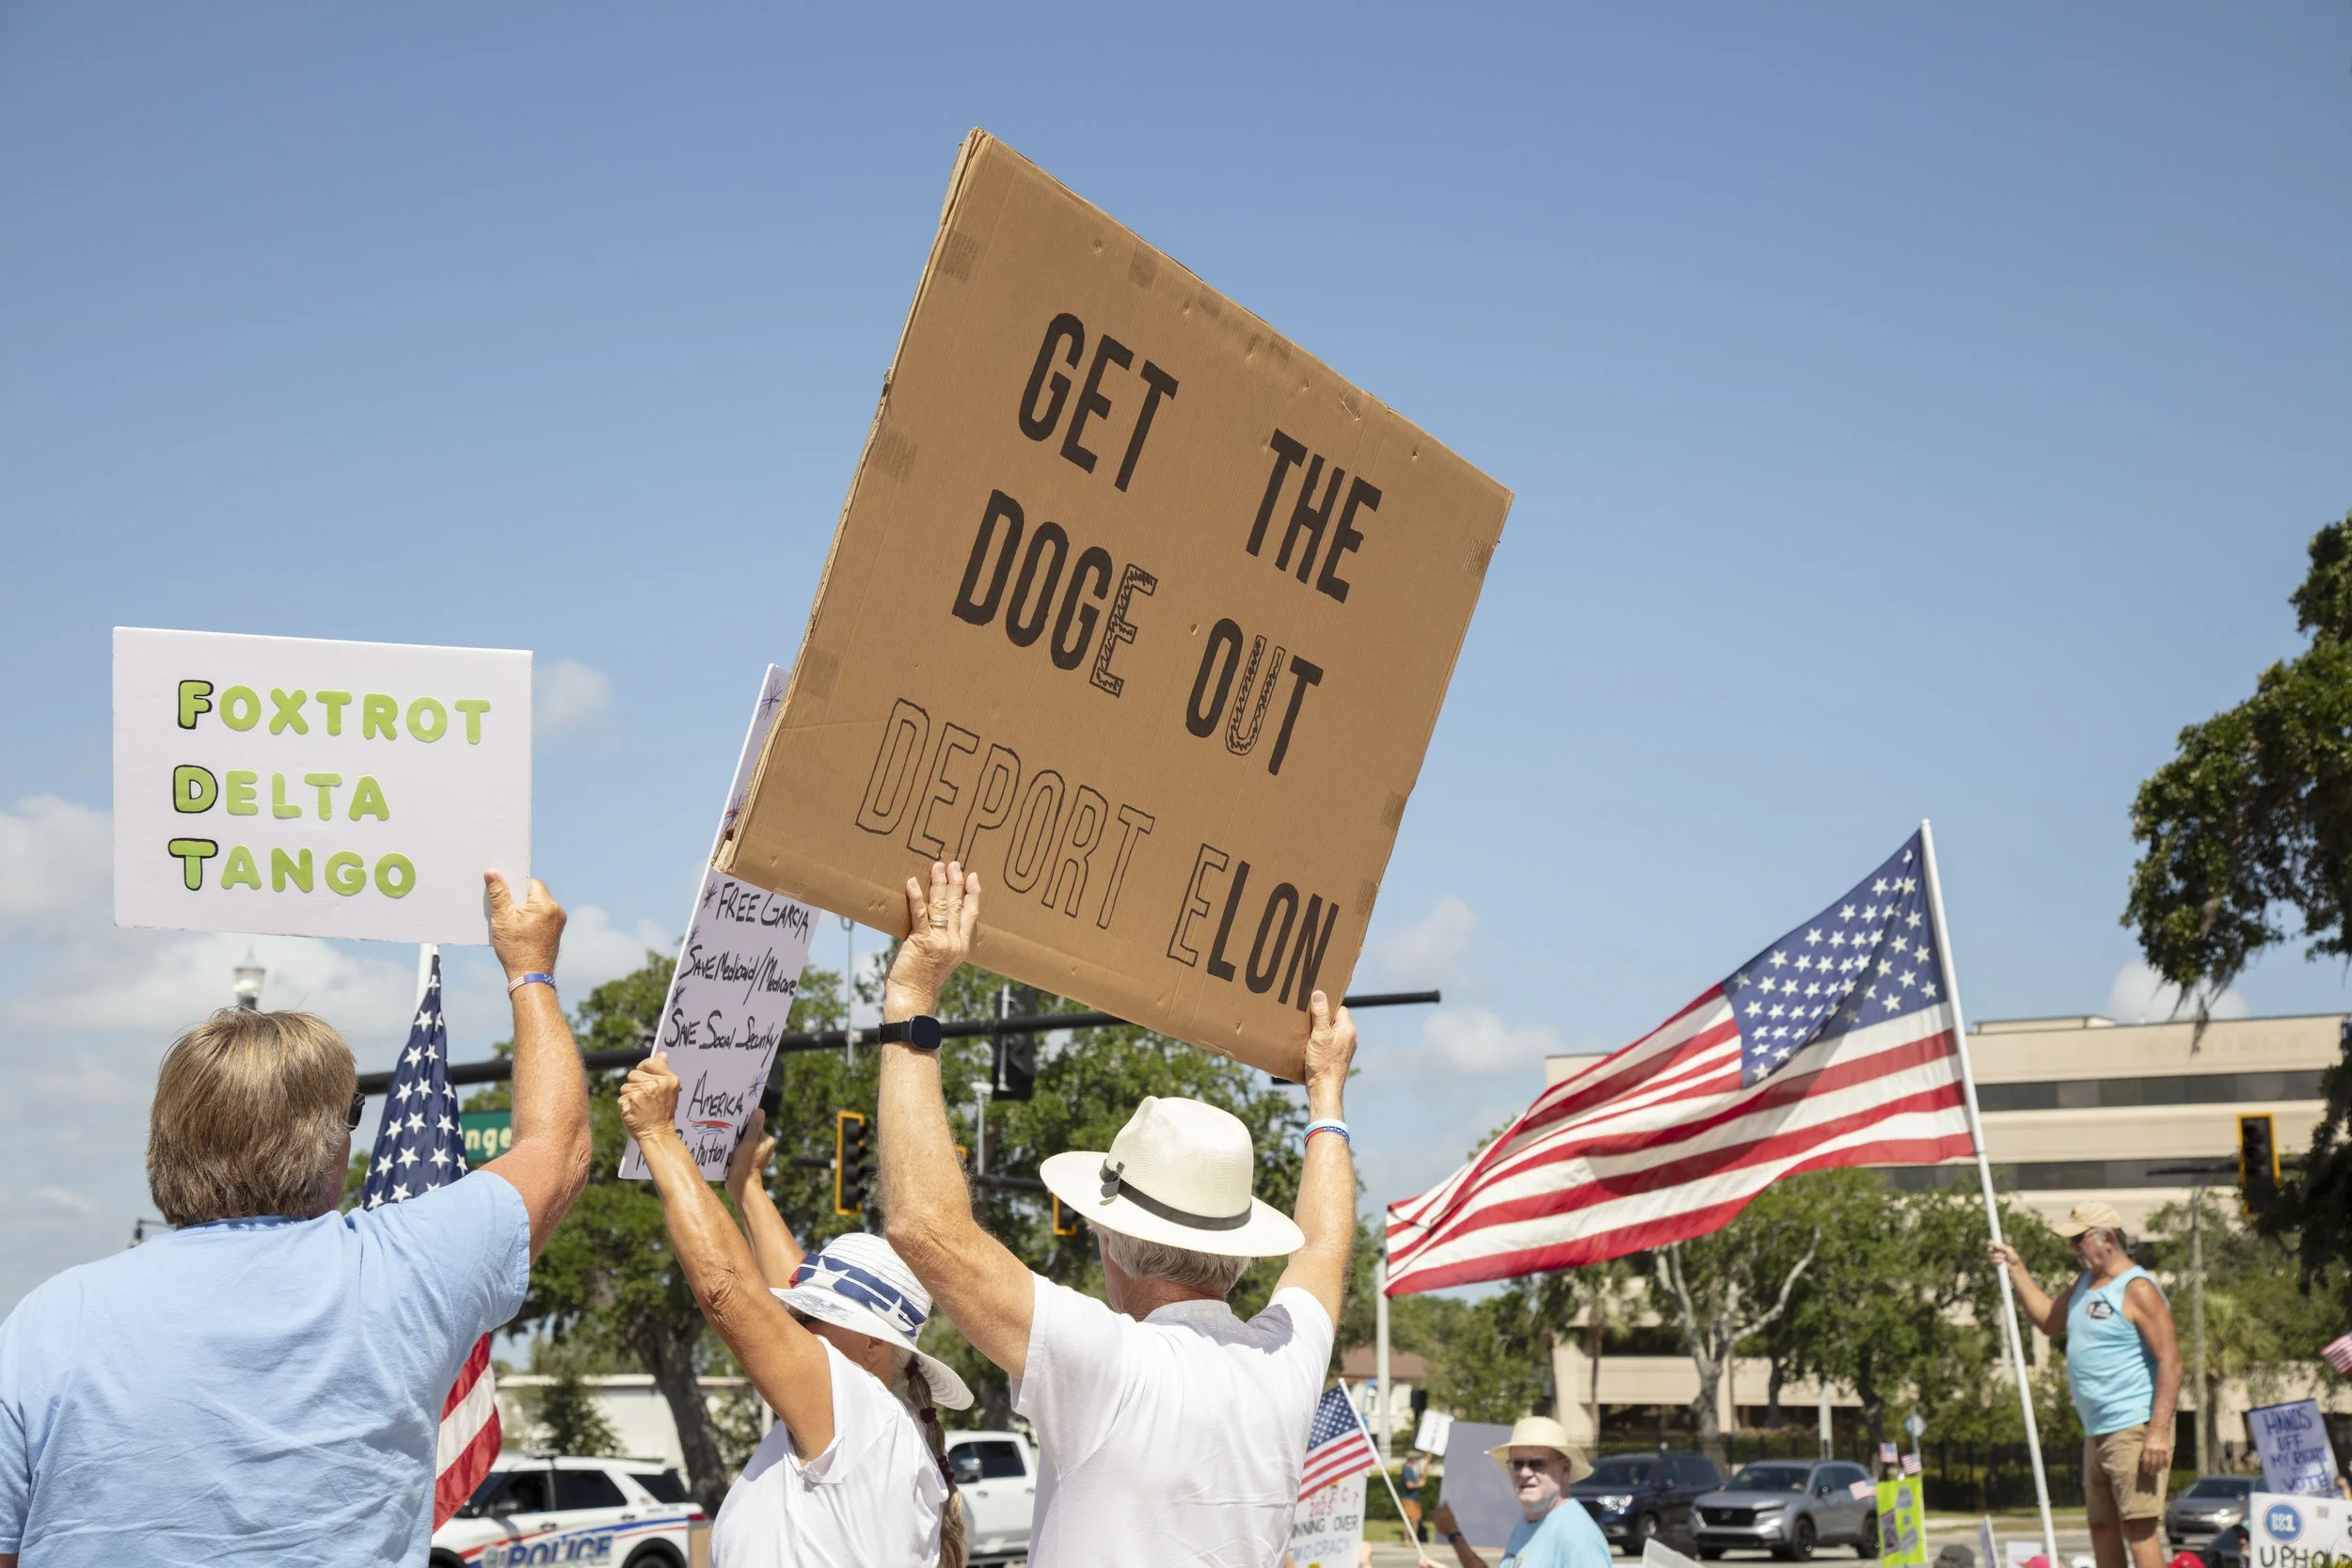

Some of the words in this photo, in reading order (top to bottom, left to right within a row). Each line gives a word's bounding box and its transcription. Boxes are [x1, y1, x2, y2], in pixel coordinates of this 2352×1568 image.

[1018, 312, 1179, 493] GET
[1246, 428, 1382, 604] THE
[951, 489, 1158, 698] DOGE
[1185, 618, 1324, 775] OUT
[178, 679, 491, 745] FOXTROT
[172, 764, 390, 822] DELTA
[167, 838, 416, 899] TANGO
[855, 698, 1155, 928] DEPORT
[1167, 843, 1340, 1013] ELON
[716, 882, 760, 923] FREE
[761, 894, 810, 943] GARCIA
[678, 944, 716, 980] SAVE
[664, 1008, 700, 1048] SAVE
[699, 1009, 737, 1050] Social
[736, 1015, 778, 1069] Security
[465, 1127, 512, 1158] nge
[2264, 1405, 2313, 1434] HANDS
[507, 1534, 612, 1568] POLICE
[1333, 1514, 1359, 1531] OVER
